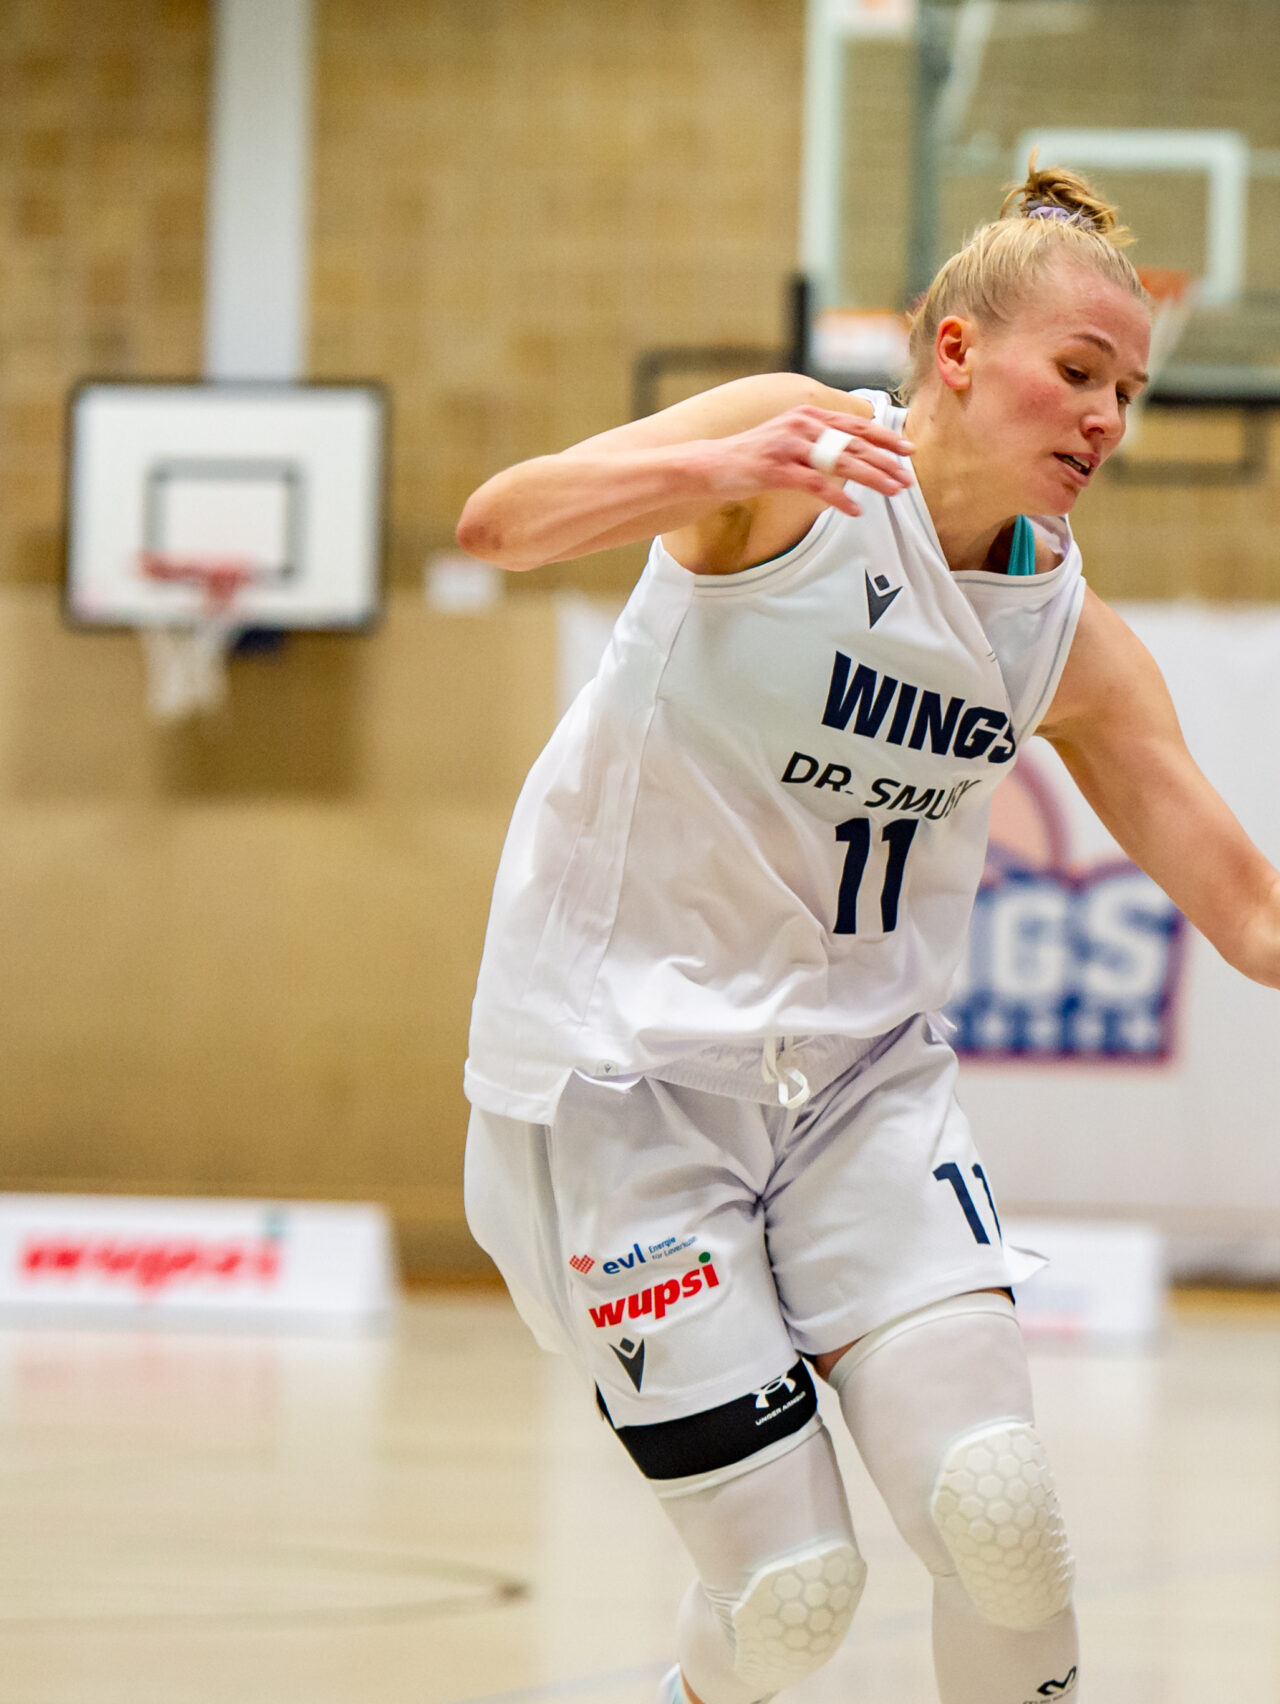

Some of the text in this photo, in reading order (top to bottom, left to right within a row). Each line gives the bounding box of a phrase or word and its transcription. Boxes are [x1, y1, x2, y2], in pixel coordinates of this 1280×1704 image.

[821, 650, 1016, 764] WINGS
[833, 817, 919, 935] 11
[588, 1251, 719, 1328] wupsi
[602, 1243, 647, 1275] evl
[755, 1407, 782, 1426] UNDER
